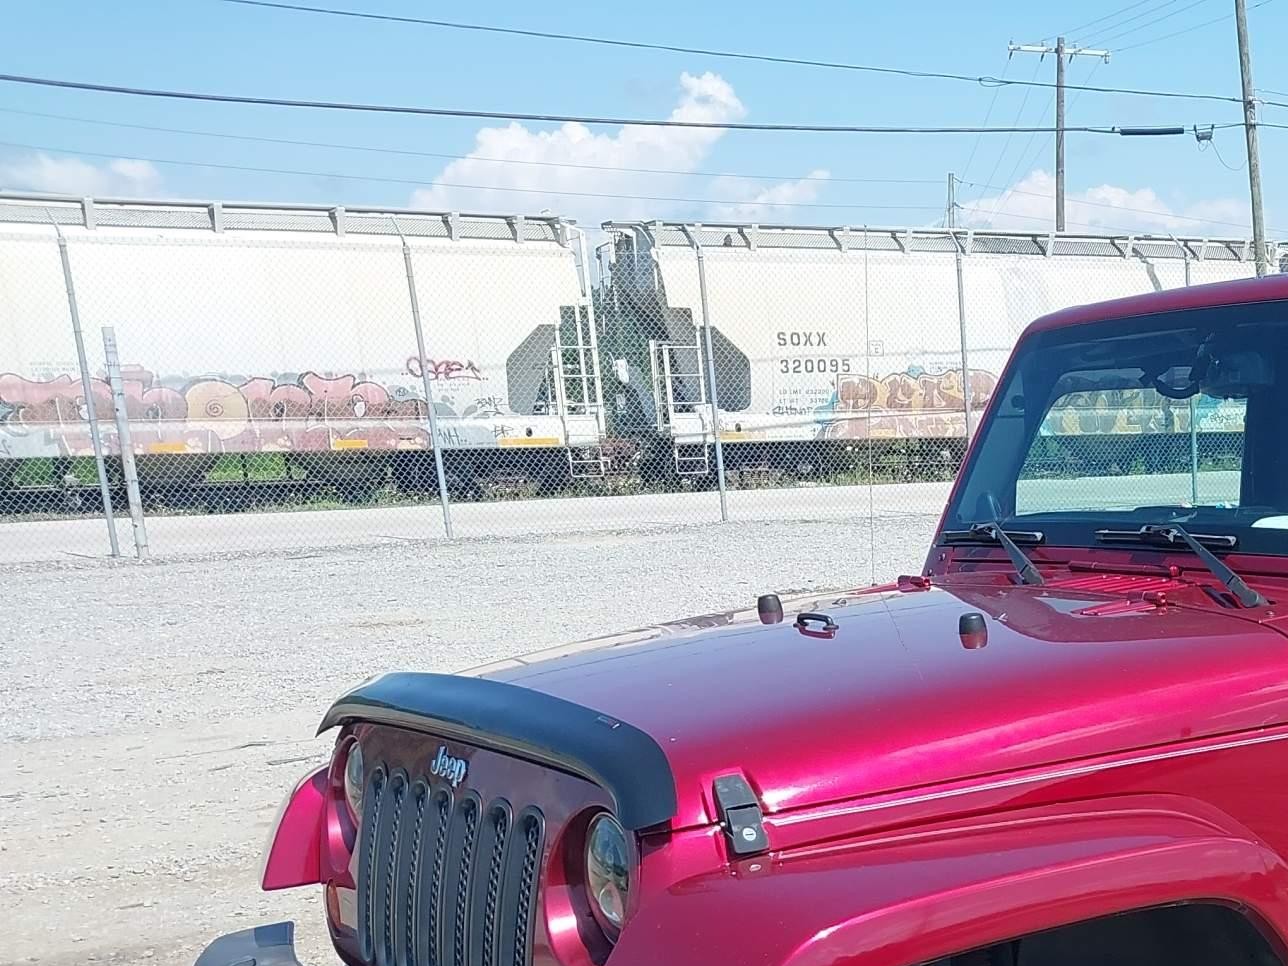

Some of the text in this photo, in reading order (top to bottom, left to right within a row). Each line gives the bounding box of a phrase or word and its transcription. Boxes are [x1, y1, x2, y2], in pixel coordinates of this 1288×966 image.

[777, 331, 827, 346] SOXX
[780, 358, 851, 374] 320095
[431, 745, 467, 788] Jeep
